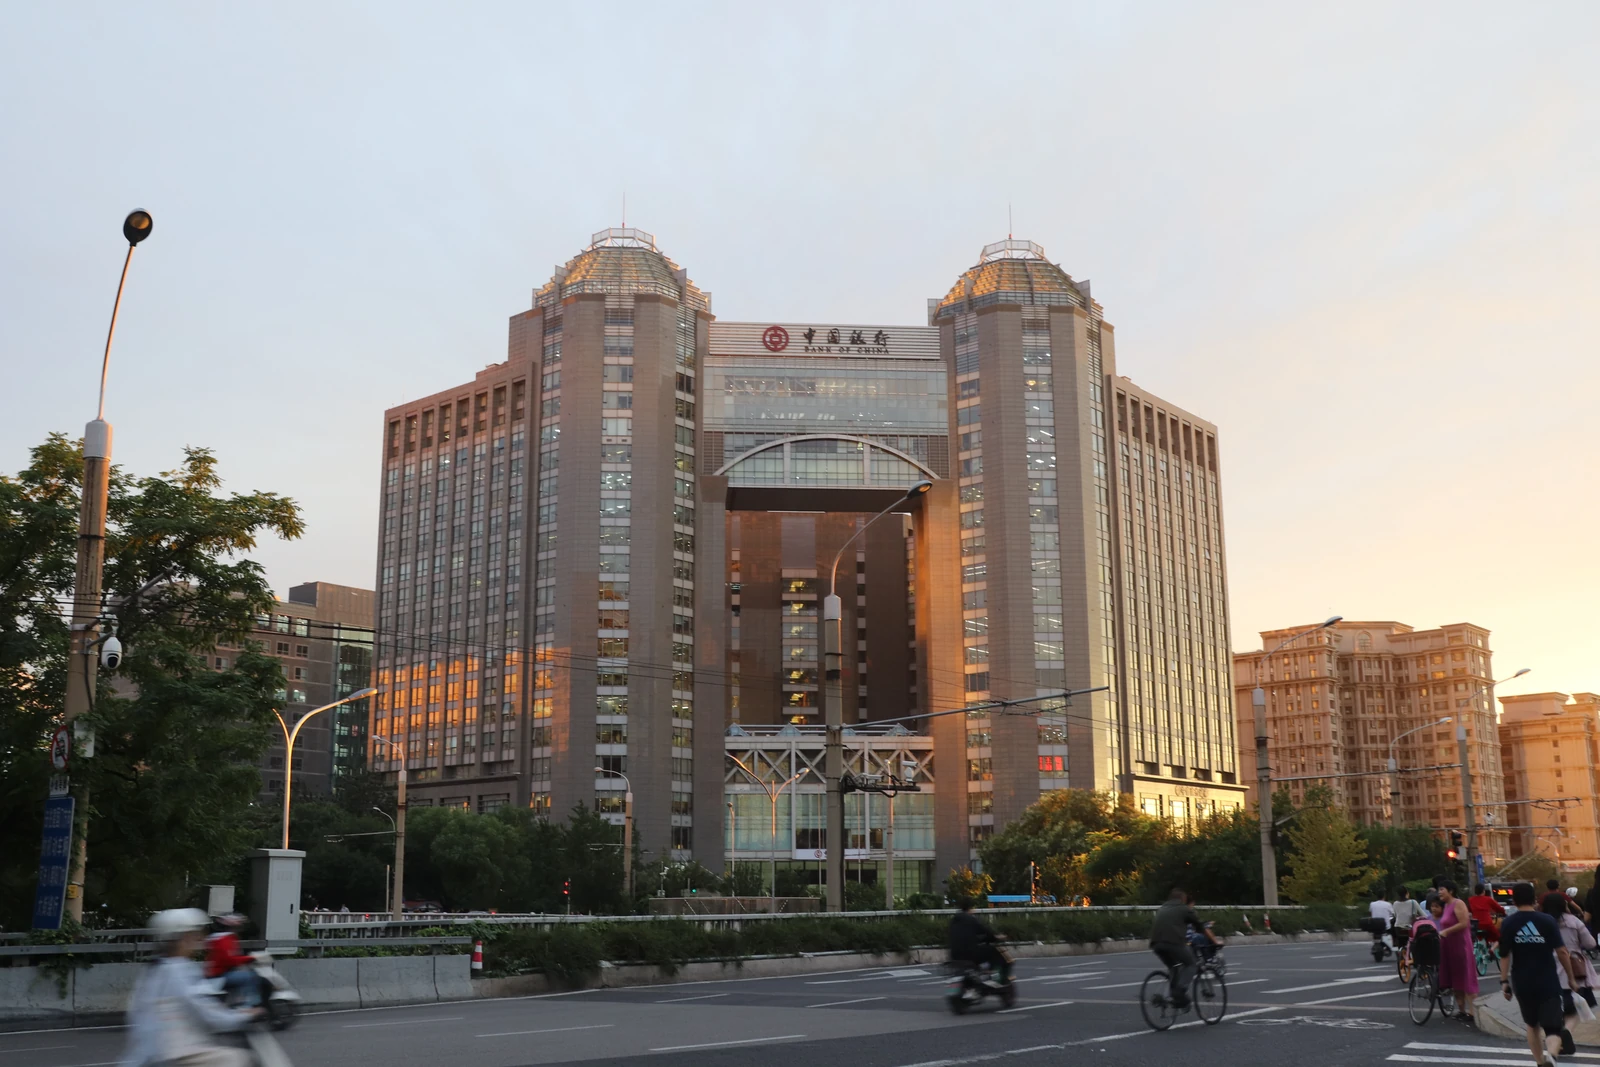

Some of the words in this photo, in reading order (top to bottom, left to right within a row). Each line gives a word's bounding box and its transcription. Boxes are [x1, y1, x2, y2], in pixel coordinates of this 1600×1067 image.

[803, 327, 890, 347] 中国银行
[839, 346, 850, 354] OF
[1514, 935, 1546, 944] adidas
